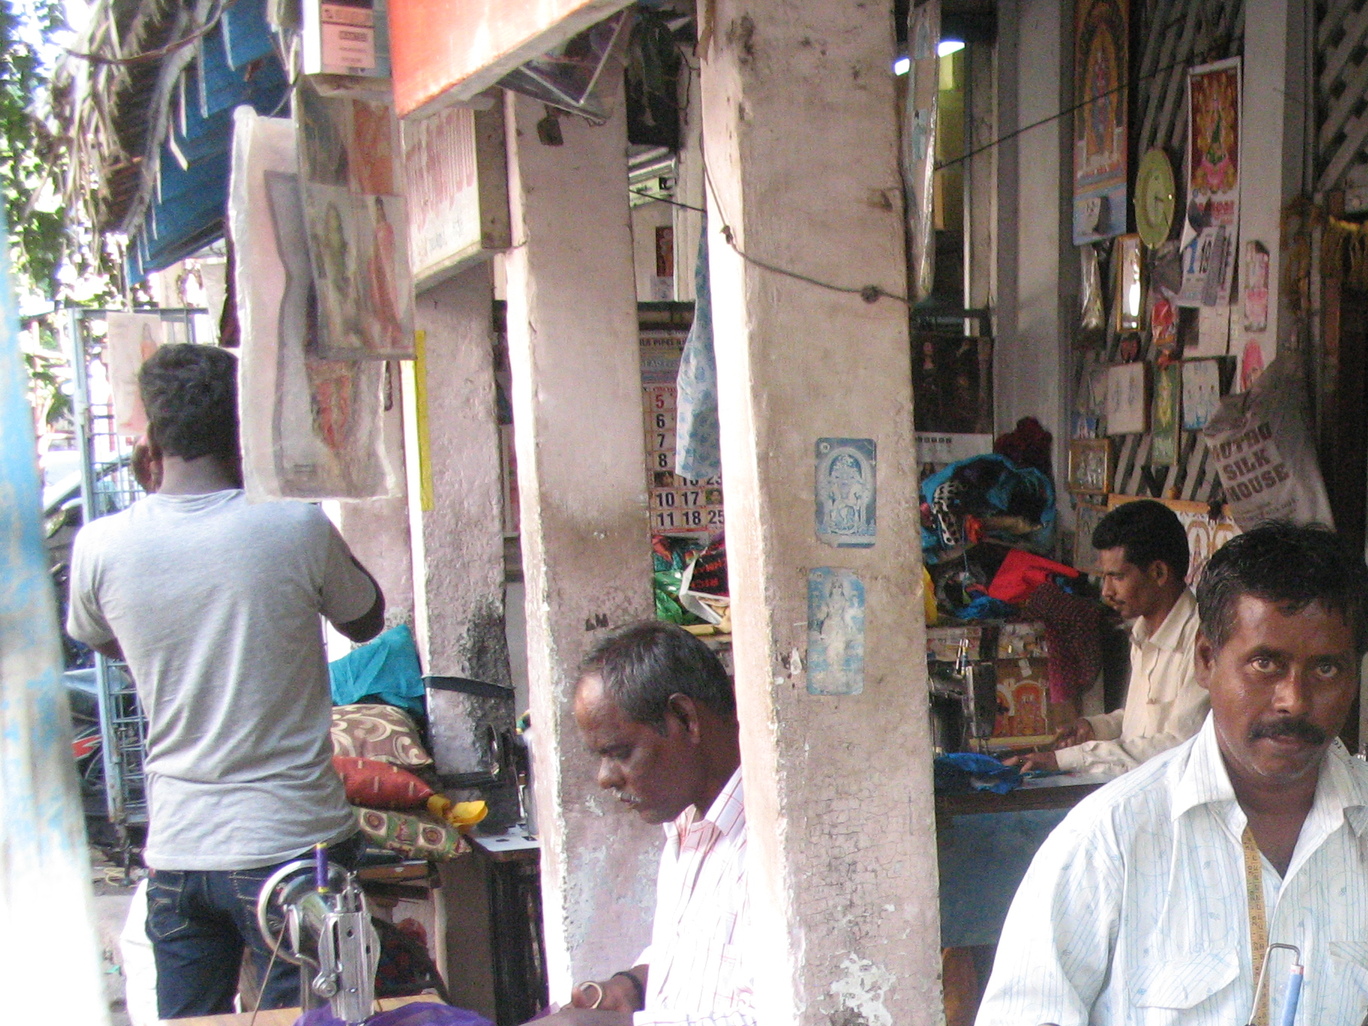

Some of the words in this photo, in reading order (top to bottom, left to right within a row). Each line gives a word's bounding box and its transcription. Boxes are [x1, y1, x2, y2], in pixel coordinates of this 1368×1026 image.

[655, 394, 665, 409] 5
[656, 413, 665, 429] 6
[657, 433, 665, 448] 7
[658, 453, 667, 468] 8
[1223, 448, 1271, 481] SILK
[1227, 462, 1290, 501] HOUSE
[656, 491, 675, 507] 10
[682, 491, 699, 507] 17
[656, 511, 674, 526] 11
[682, 510, 702, 526] 18
